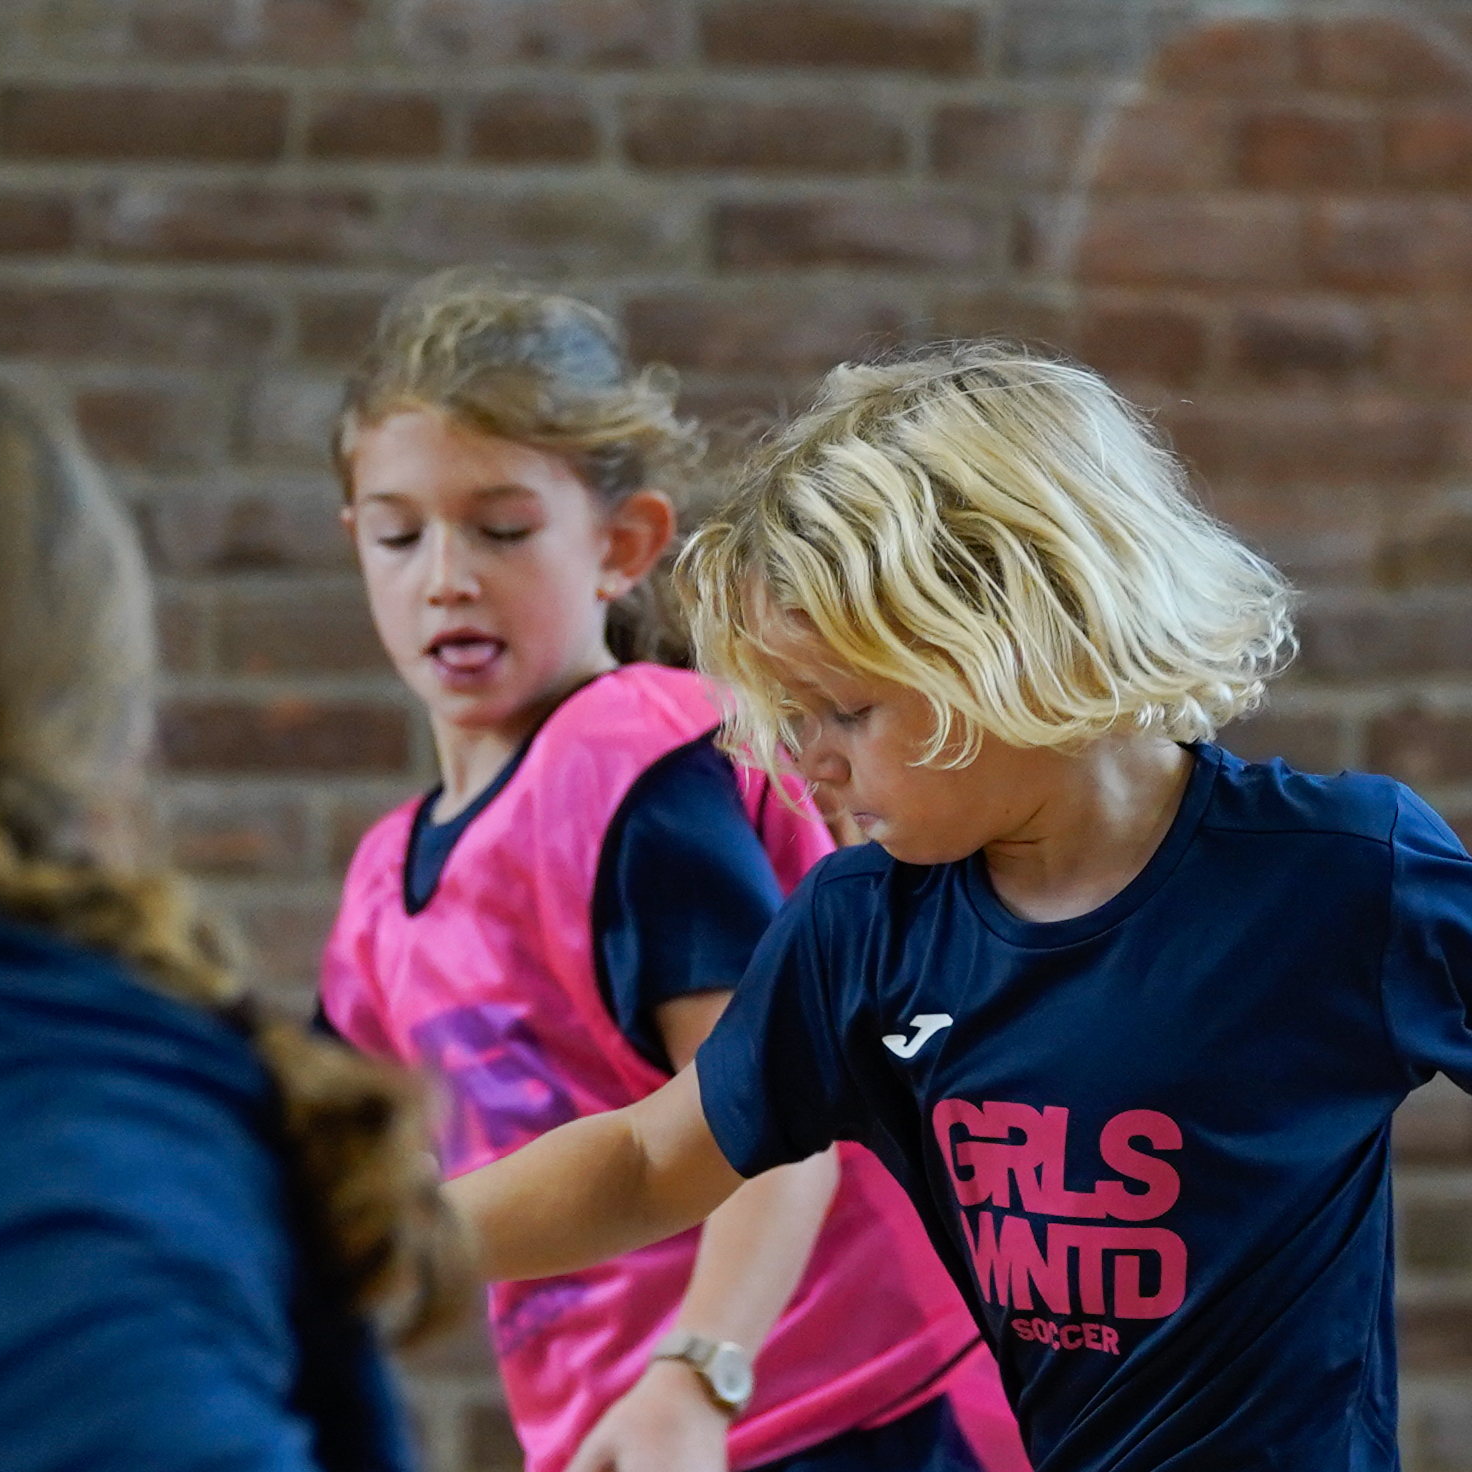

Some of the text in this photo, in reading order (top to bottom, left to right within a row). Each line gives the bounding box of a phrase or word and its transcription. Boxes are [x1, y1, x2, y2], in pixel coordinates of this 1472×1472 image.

[932, 1098, 1183, 1222] GRLS
[960, 1211, 1188, 1320] WNTD
[1011, 1317, 1120, 1356] SOCCER
